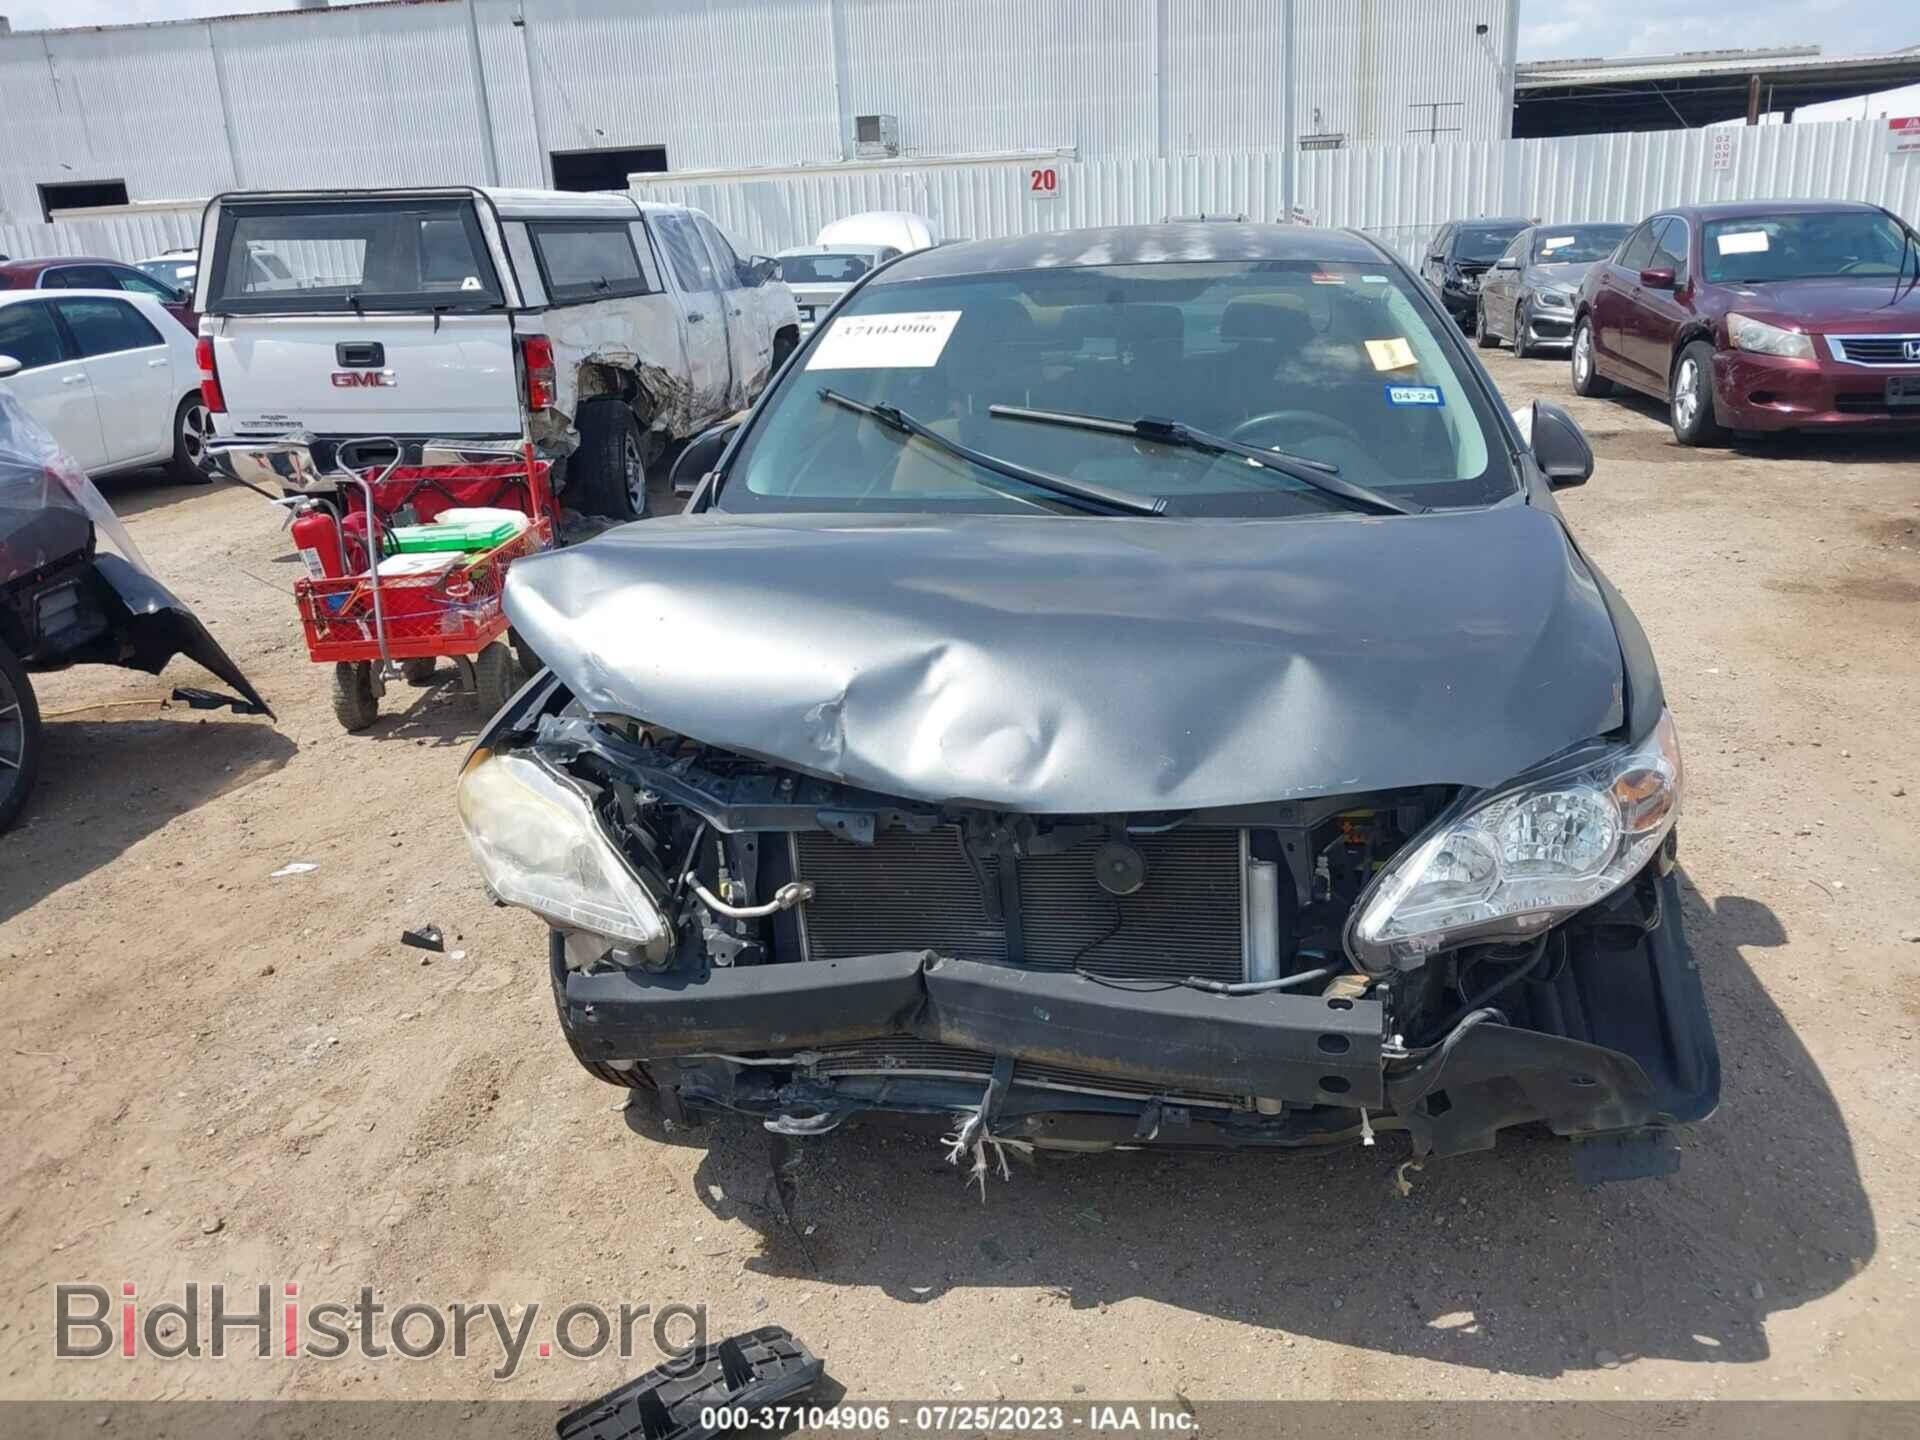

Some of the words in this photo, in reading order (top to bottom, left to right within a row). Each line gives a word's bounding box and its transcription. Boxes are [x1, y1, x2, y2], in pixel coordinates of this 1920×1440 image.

[1031, 169, 1057, 191] 20
[331, 371, 398, 387] GMC
[1393, 391, 1436, 401] 04-24
